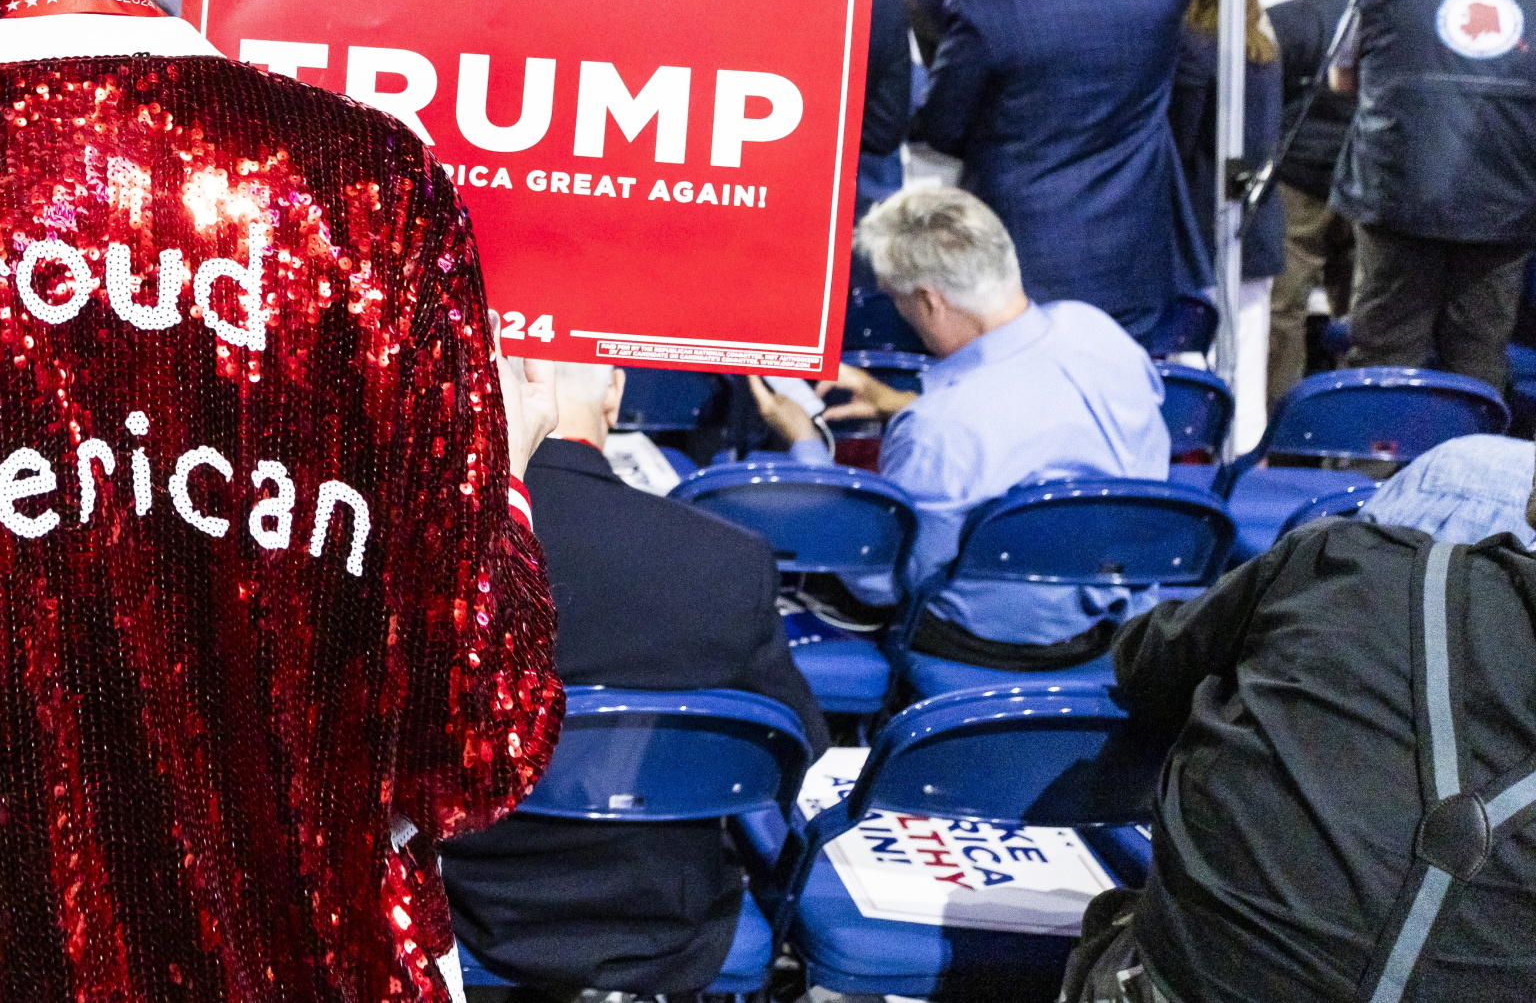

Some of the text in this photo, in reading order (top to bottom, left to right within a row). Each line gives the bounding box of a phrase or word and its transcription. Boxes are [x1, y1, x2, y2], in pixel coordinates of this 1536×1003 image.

[526, 169, 637, 199] GREAT
[648, 180, 768, 208] AGAIN!
[499, 311, 555, 343] 24
[896, 815, 976, 892] LTHY
[948, 818, 1015, 886] RICA
[992, 823, 1049, 864] KE
